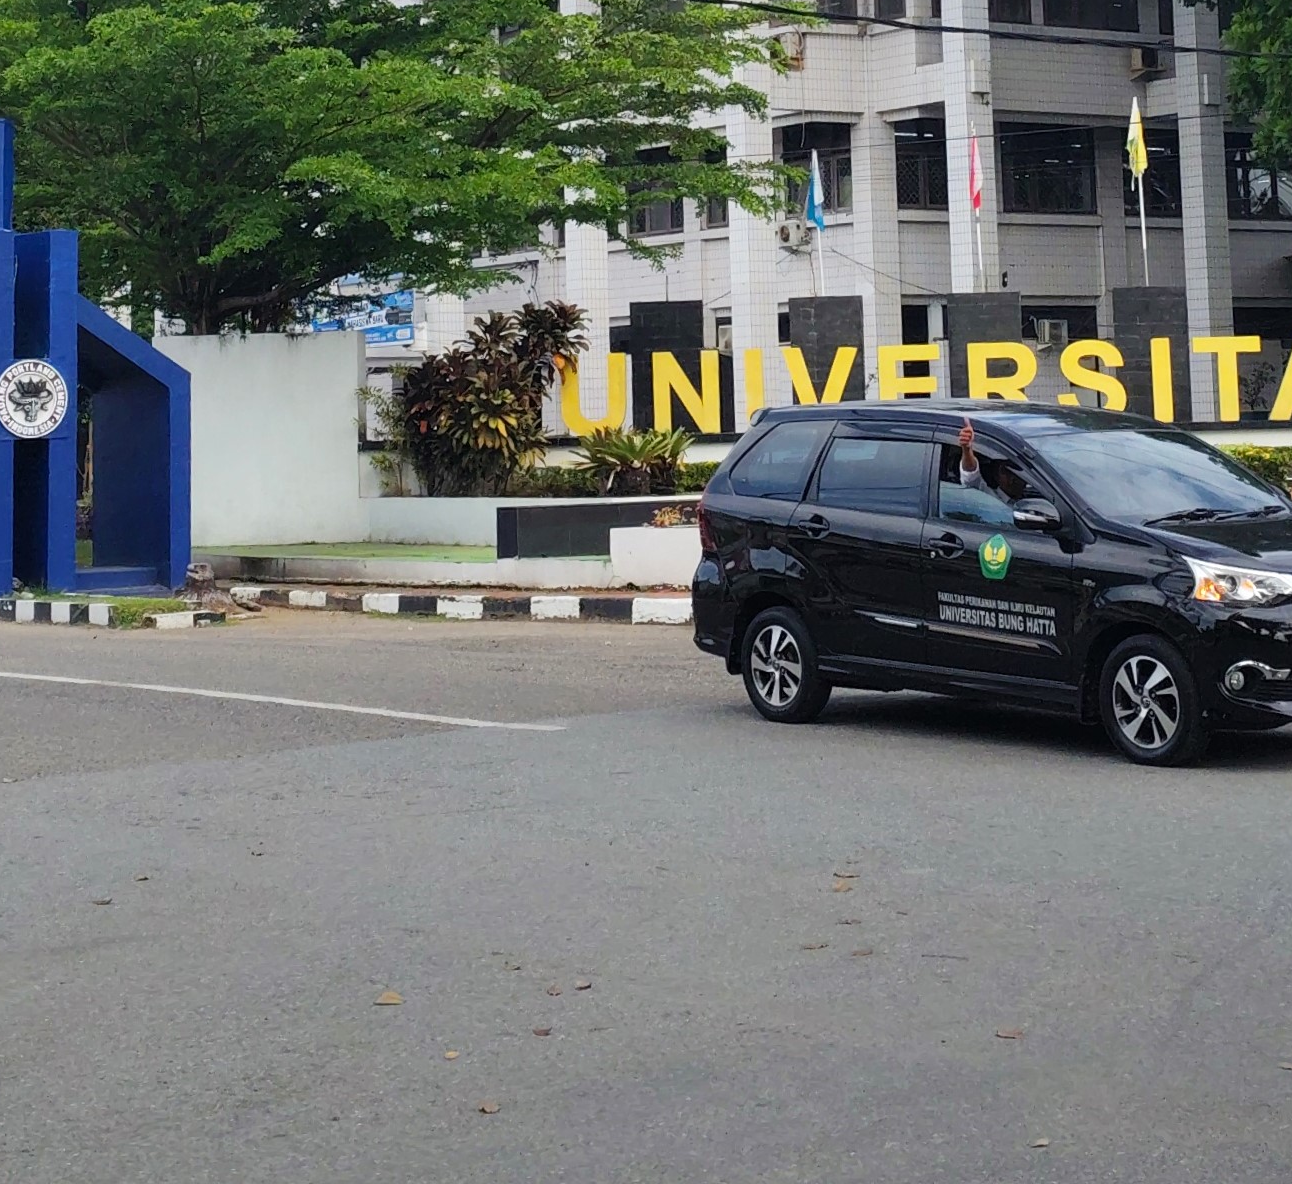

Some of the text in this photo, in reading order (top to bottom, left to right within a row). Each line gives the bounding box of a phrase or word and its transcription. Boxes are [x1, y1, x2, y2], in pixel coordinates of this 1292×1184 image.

[6, 362, 56, 381] PORTLAND
[53, 379, 65, 421] CEMENT
[7, 419, 54, 435] INDONESIA
[937, 591, 965, 604] FAKULTAS
[997, 600, 1009, 611] DAN
[1025, 603, 1056, 617] KELAUTAN
[939, 604, 1056, 636] UNIVERSITAS BUNG HATTA
